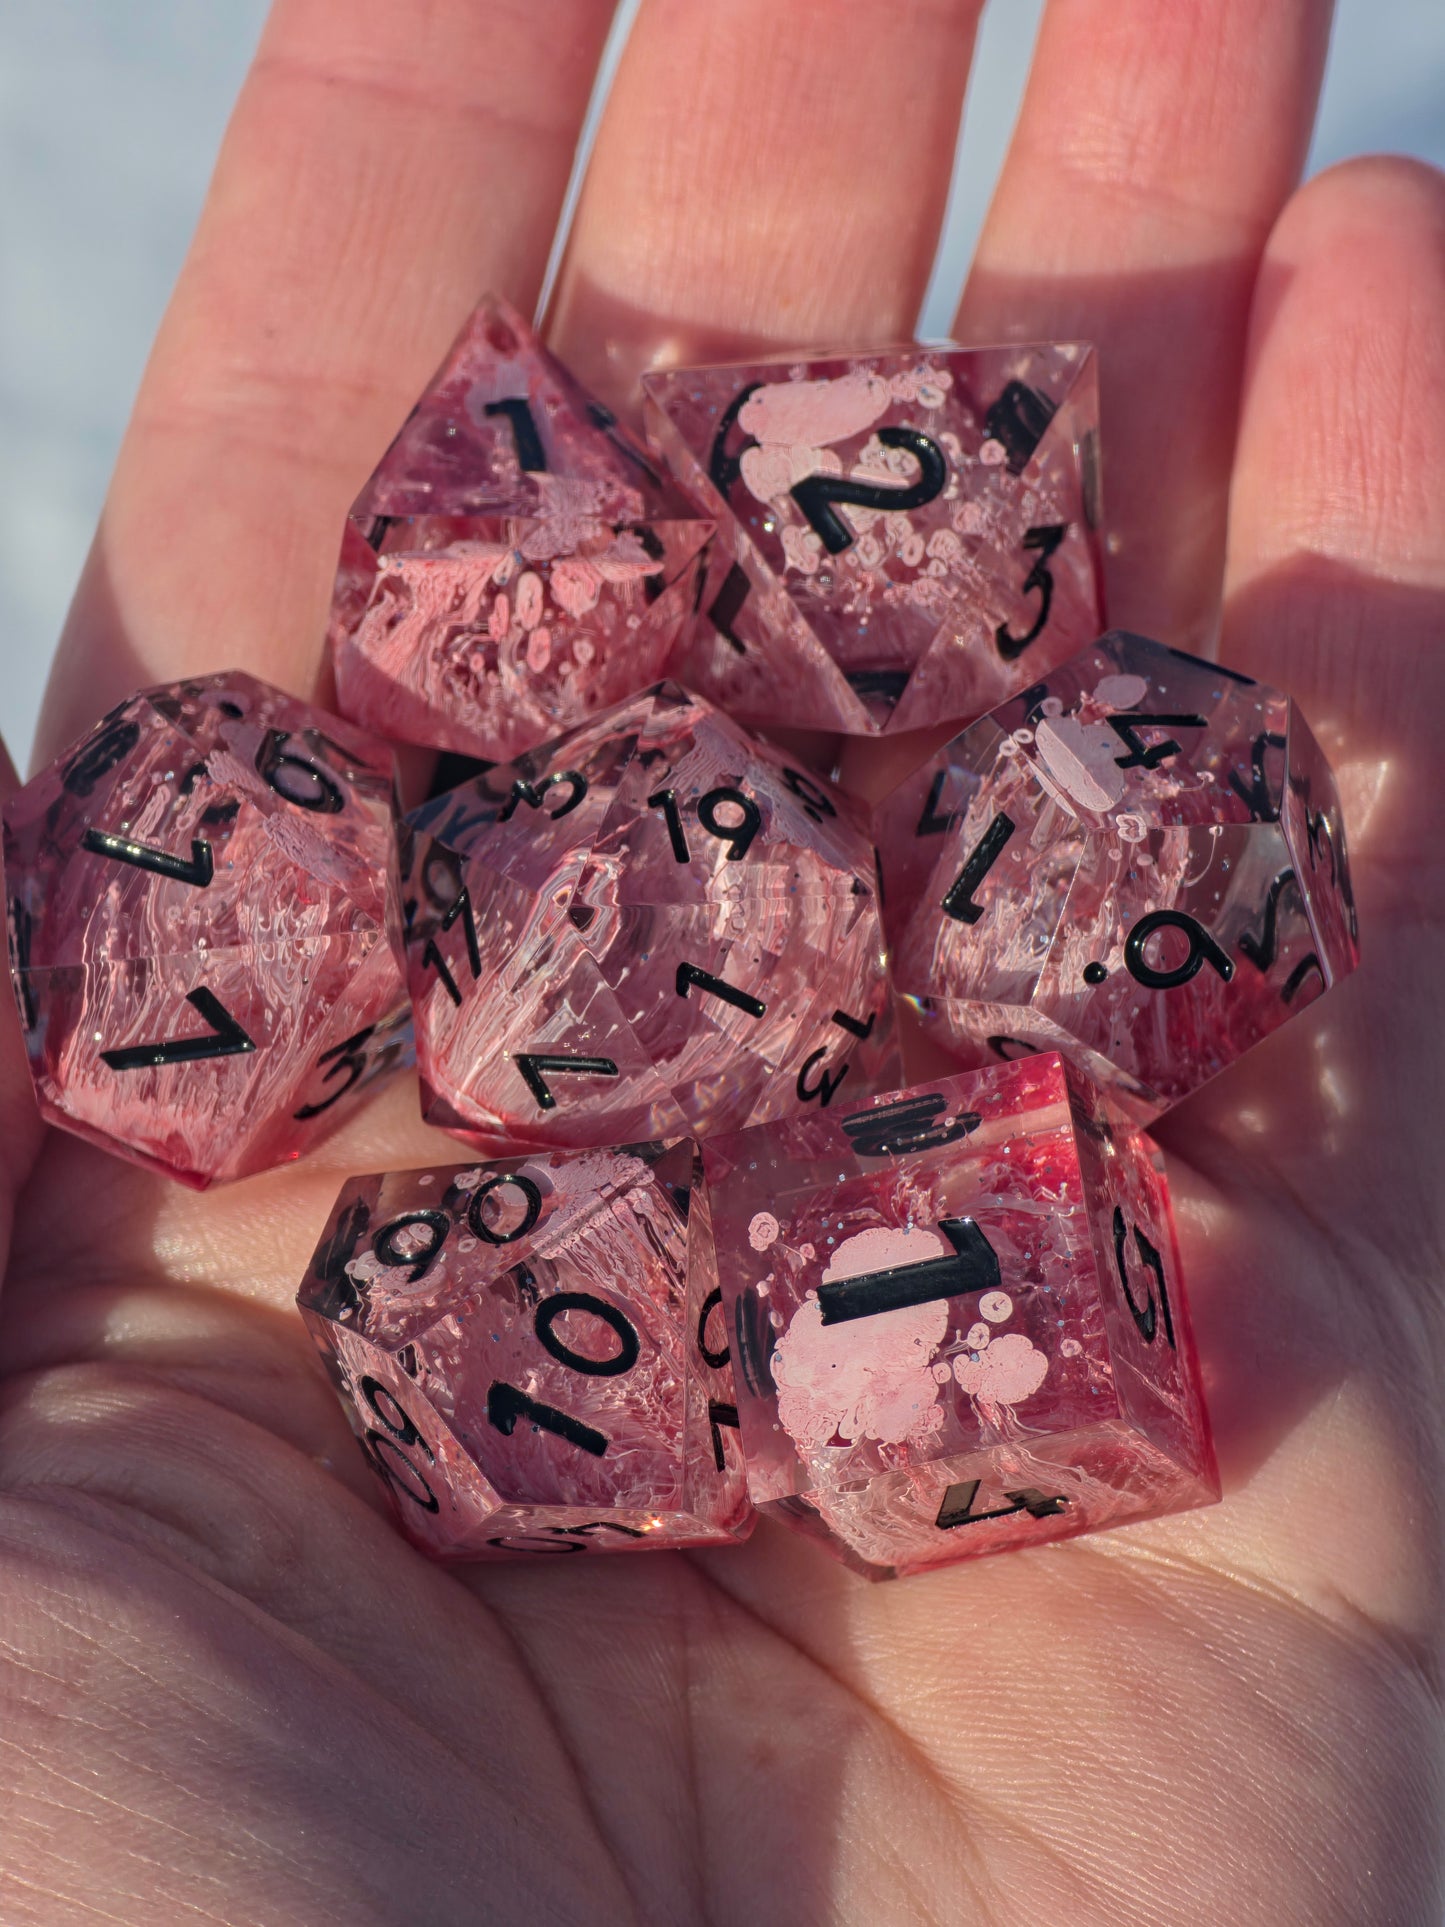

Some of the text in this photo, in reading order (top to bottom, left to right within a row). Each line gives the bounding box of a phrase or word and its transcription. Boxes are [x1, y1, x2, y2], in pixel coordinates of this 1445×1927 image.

[790, 427, 946, 555] 2
[648, 787, 762, 864] 19
[796, 1009, 876, 1108] 13
[817, 1216, 1002, 1326] 1
[487, 1292, 641, 1457] 10
